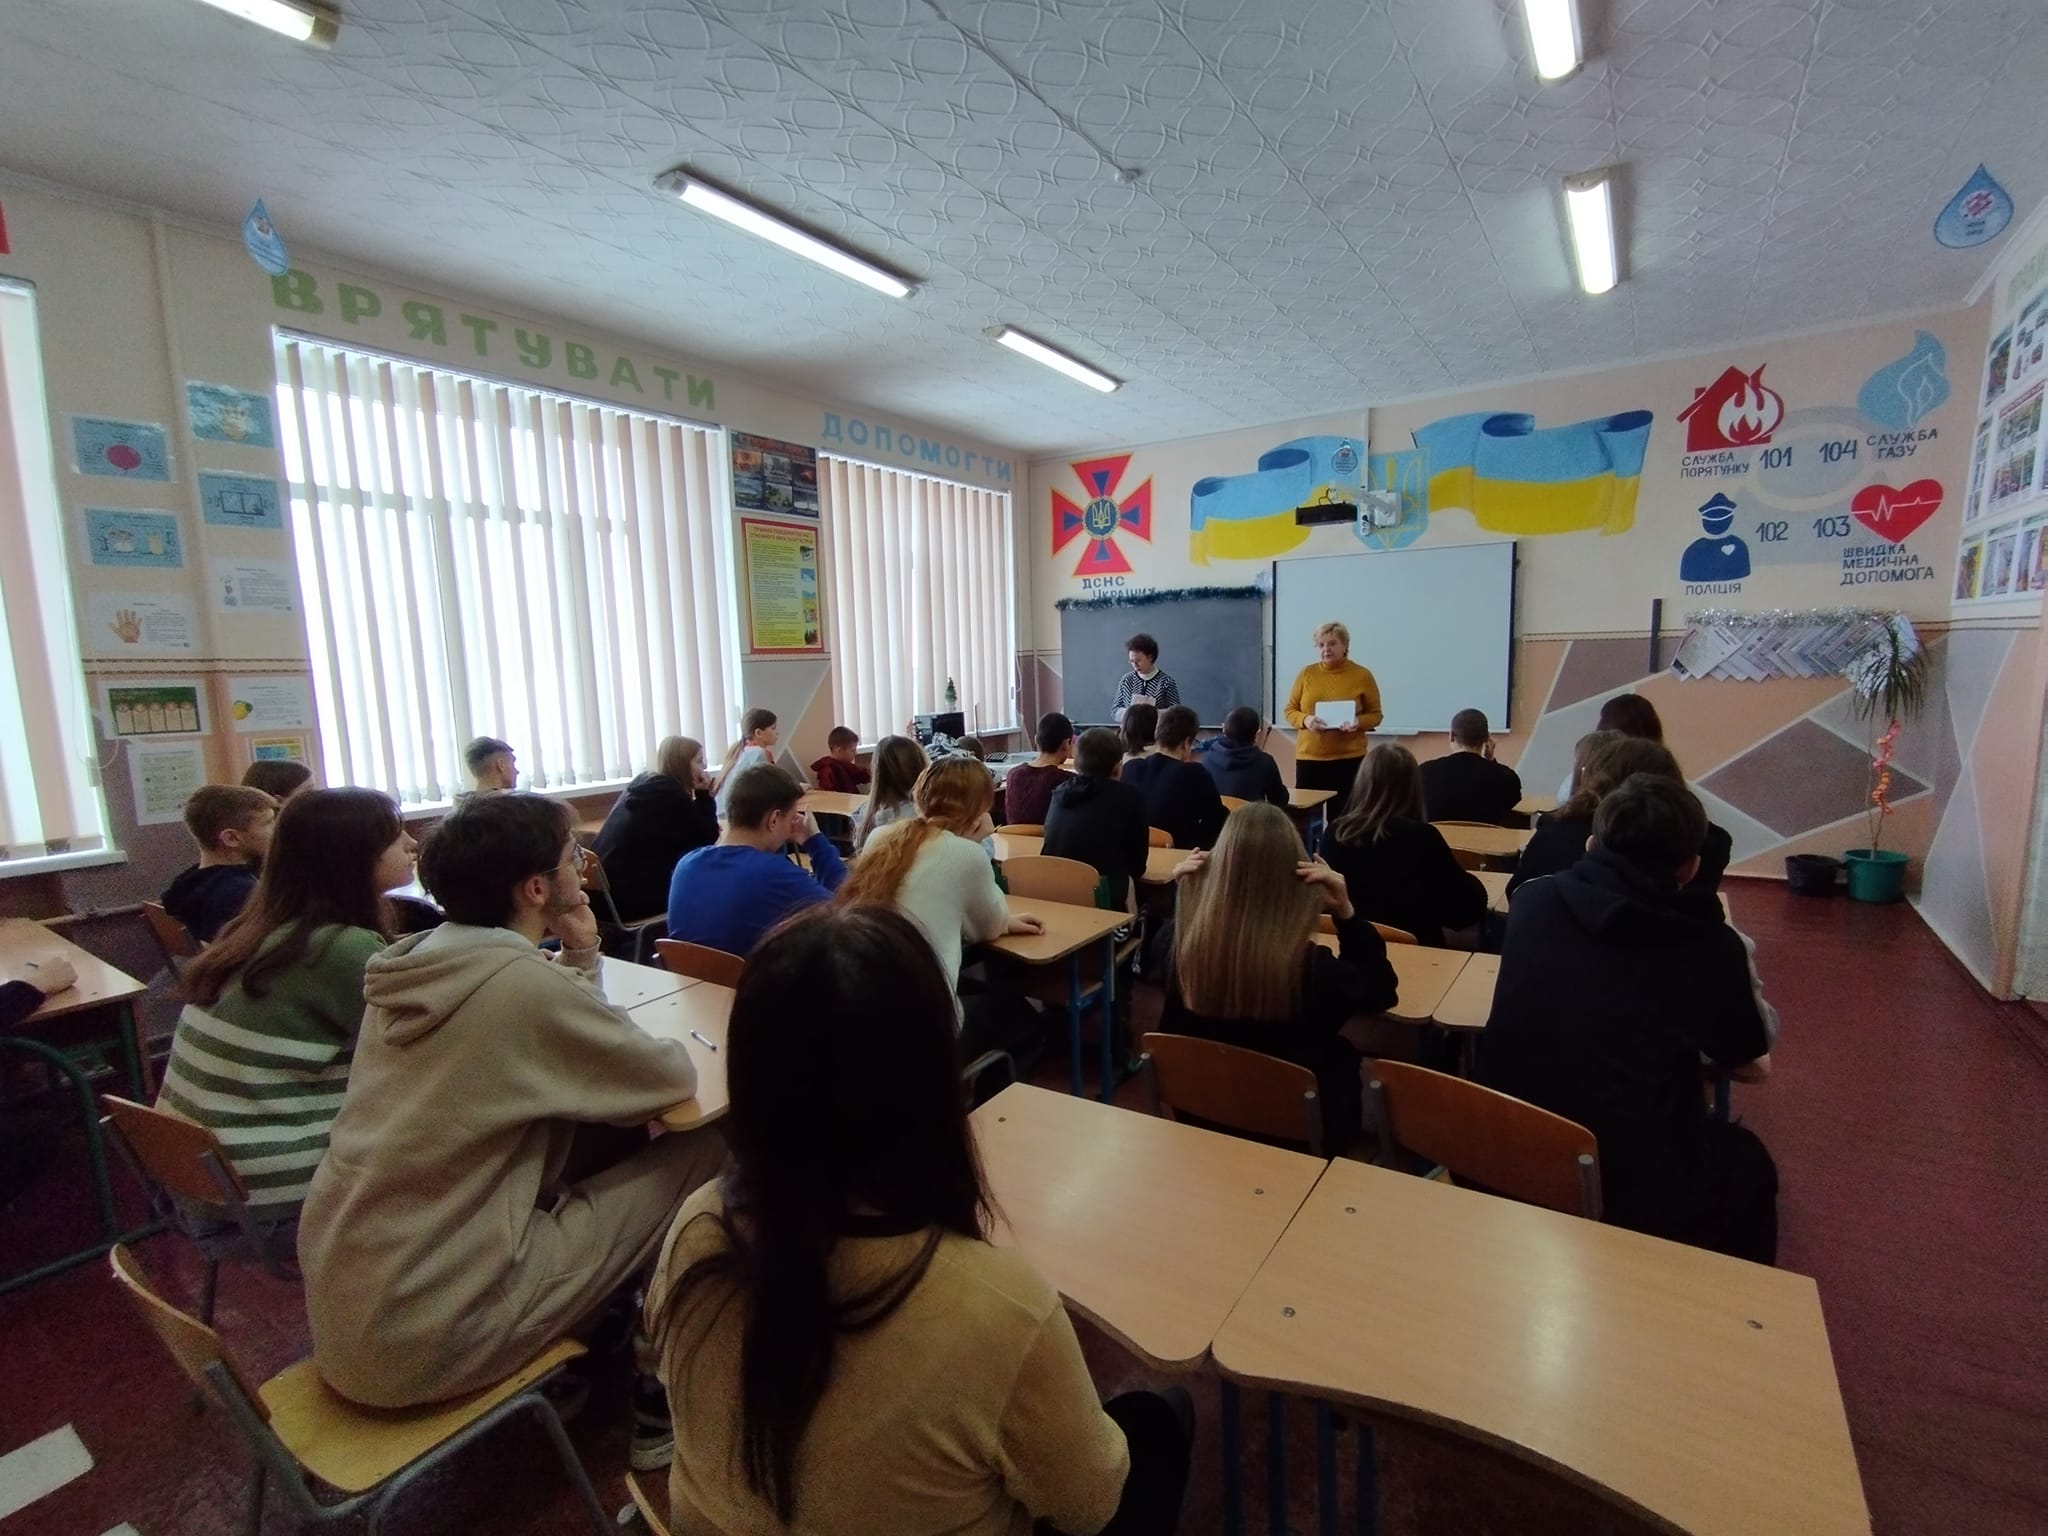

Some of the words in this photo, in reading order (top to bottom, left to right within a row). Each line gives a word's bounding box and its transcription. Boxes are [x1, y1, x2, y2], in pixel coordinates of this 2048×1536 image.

[271, 268, 715, 411] ВРЯТУВАТИ
[1866, 428, 1938, 446] СЛУЖБА
[821, 412, 1011, 482] ДОПОМОГТИ
[1819, 440, 1857, 463] 104
[1878, 444, 1917, 460] ГАЗУ
[1682, 452, 1734, 467] СЛУЖБА
[1760, 446, 1793, 470] 101
[1680, 463, 1750, 479] ПОРЯТУНКУ
[1755, 521, 1789, 542] 102
[1812, 515, 1851, 538] 103
[1843, 543, 1906, 558] ШВИДКА
[1842, 554, 1919, 570] МЕДИЧНА
[1082, 576, 1125, 590] ДСНС
[1840, 566, 1934, 586] ДОПОМОГА
[1685, 583, 1742, 596] ПОЛІЦІЯ
